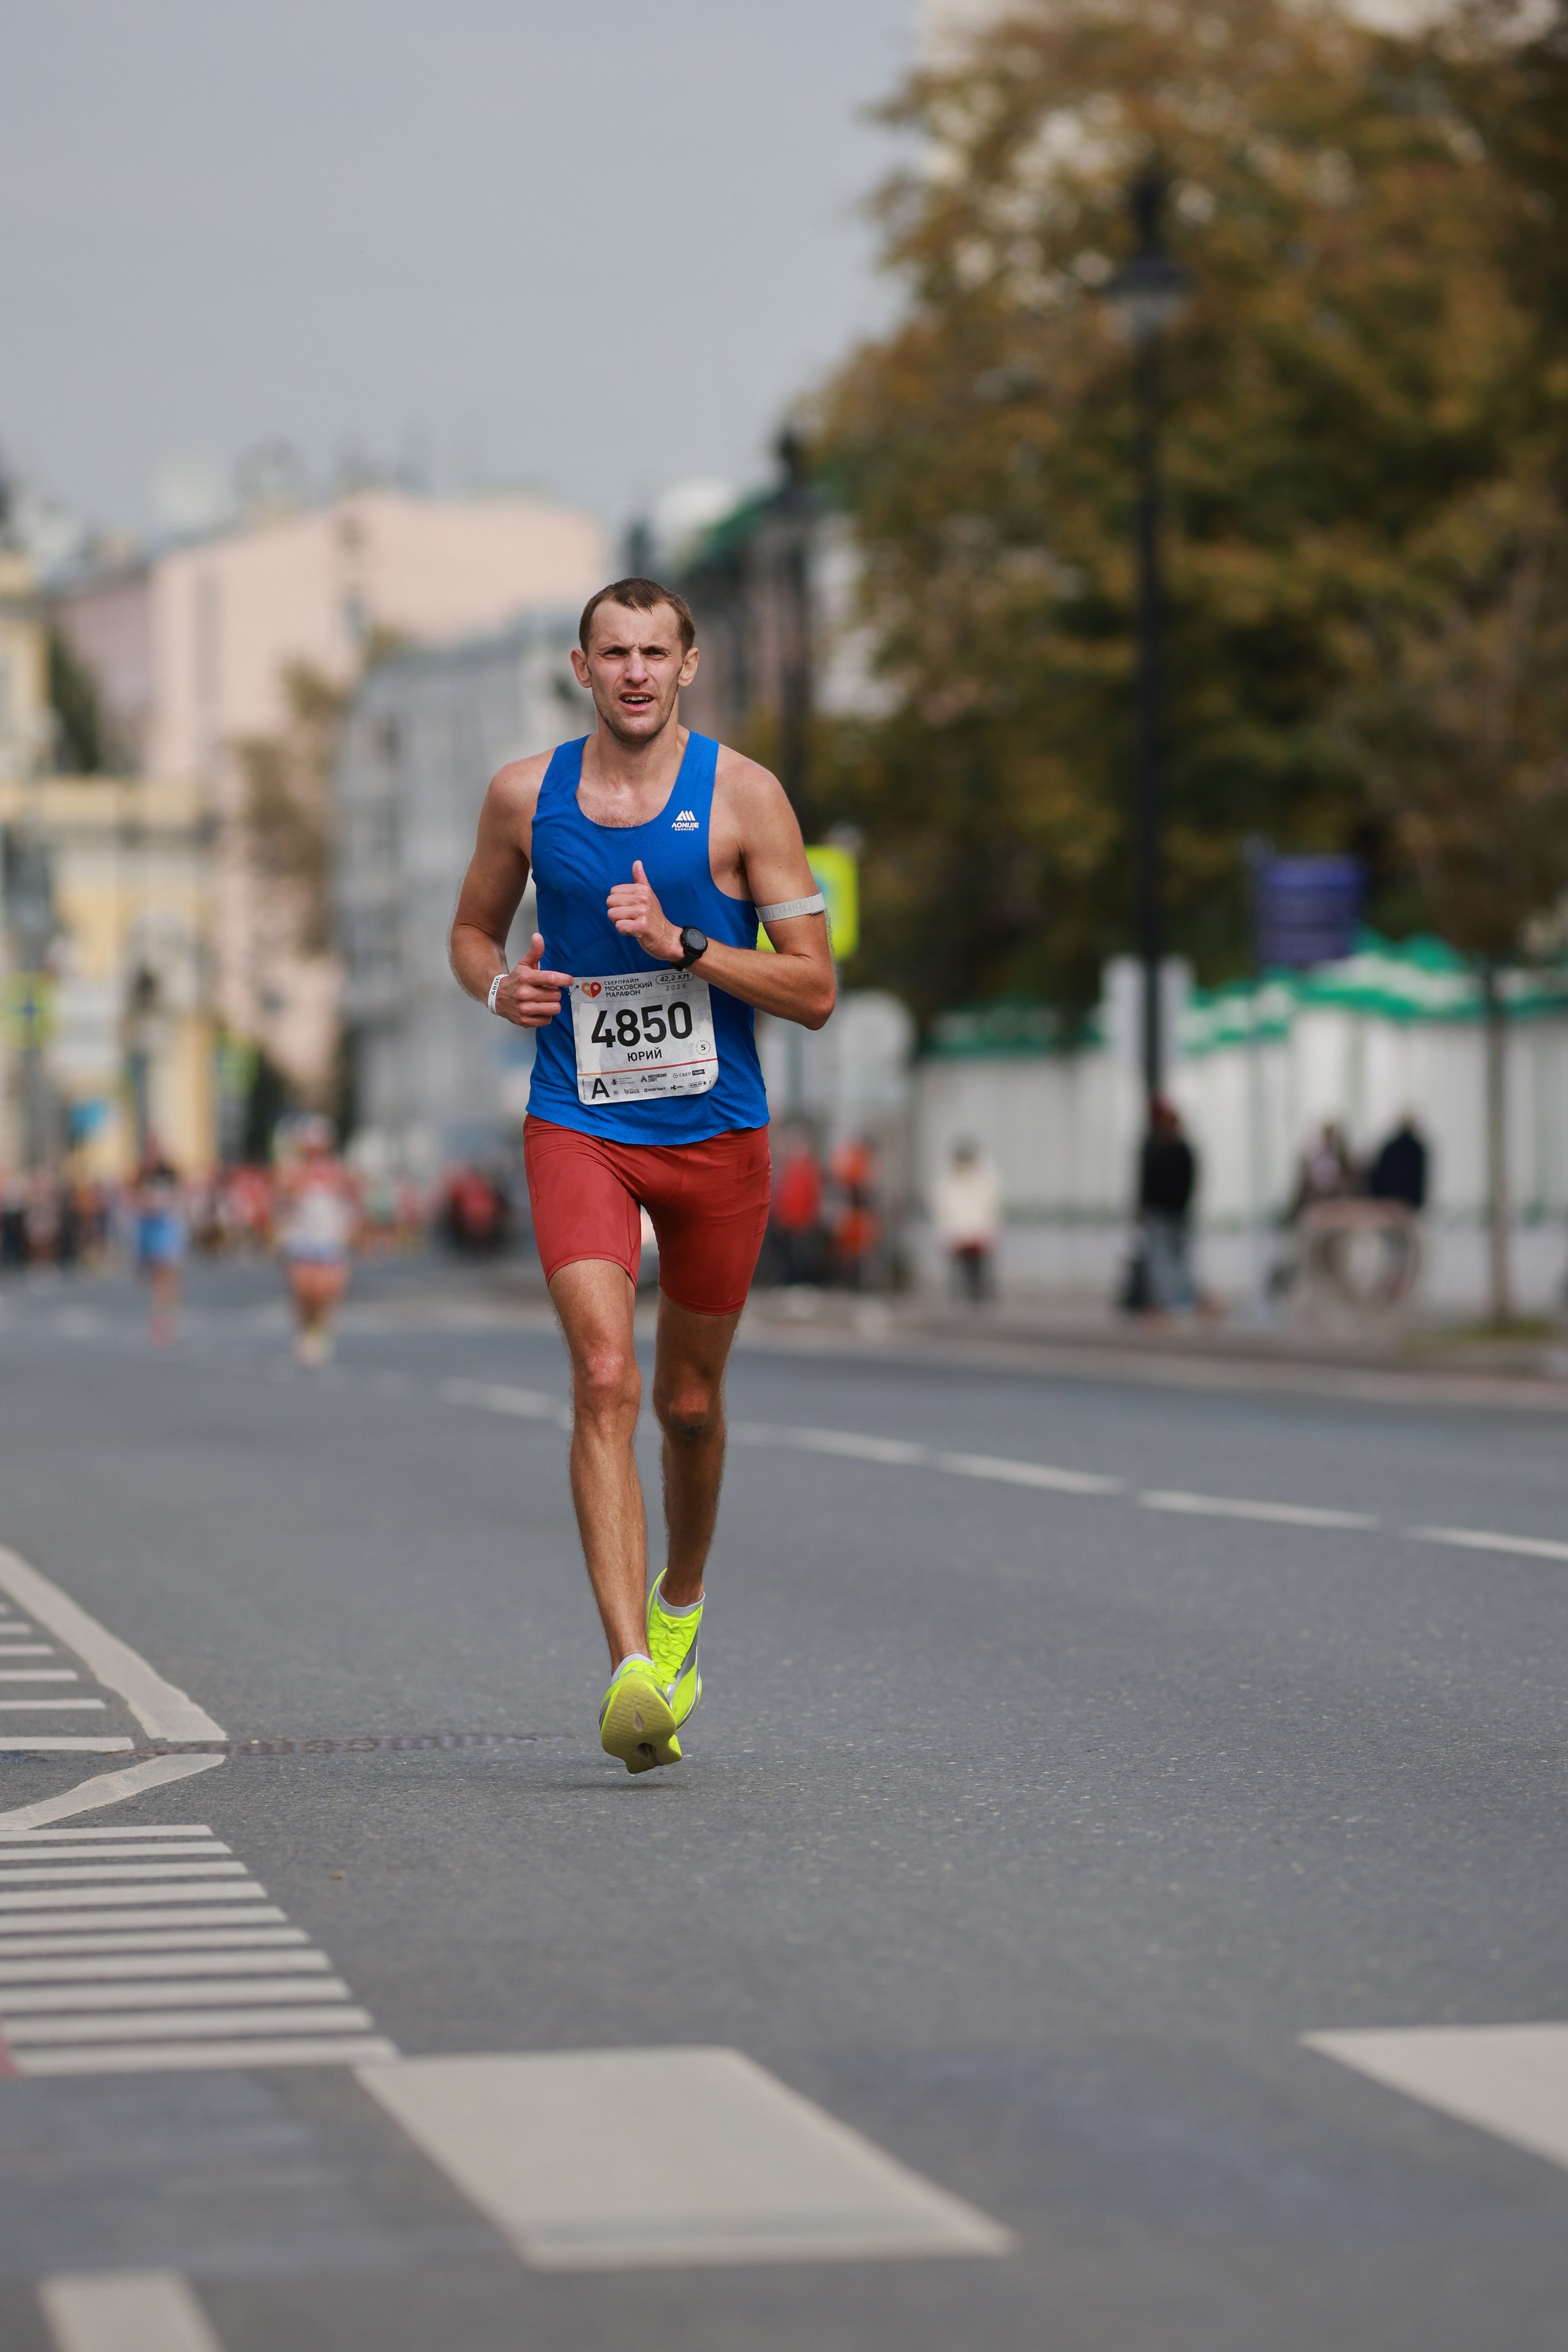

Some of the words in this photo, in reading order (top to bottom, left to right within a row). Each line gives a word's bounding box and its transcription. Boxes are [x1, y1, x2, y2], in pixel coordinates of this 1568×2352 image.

[491, 976, 500, 995] 4850
[605, 981, 653, 992] МОСКОВСКИЙ
[606, 989, 641, 998] МАРАФОН
[591, 1001, 693, 1048] 4850
[627, 1047, 662, 1061] ЮРИЙ
